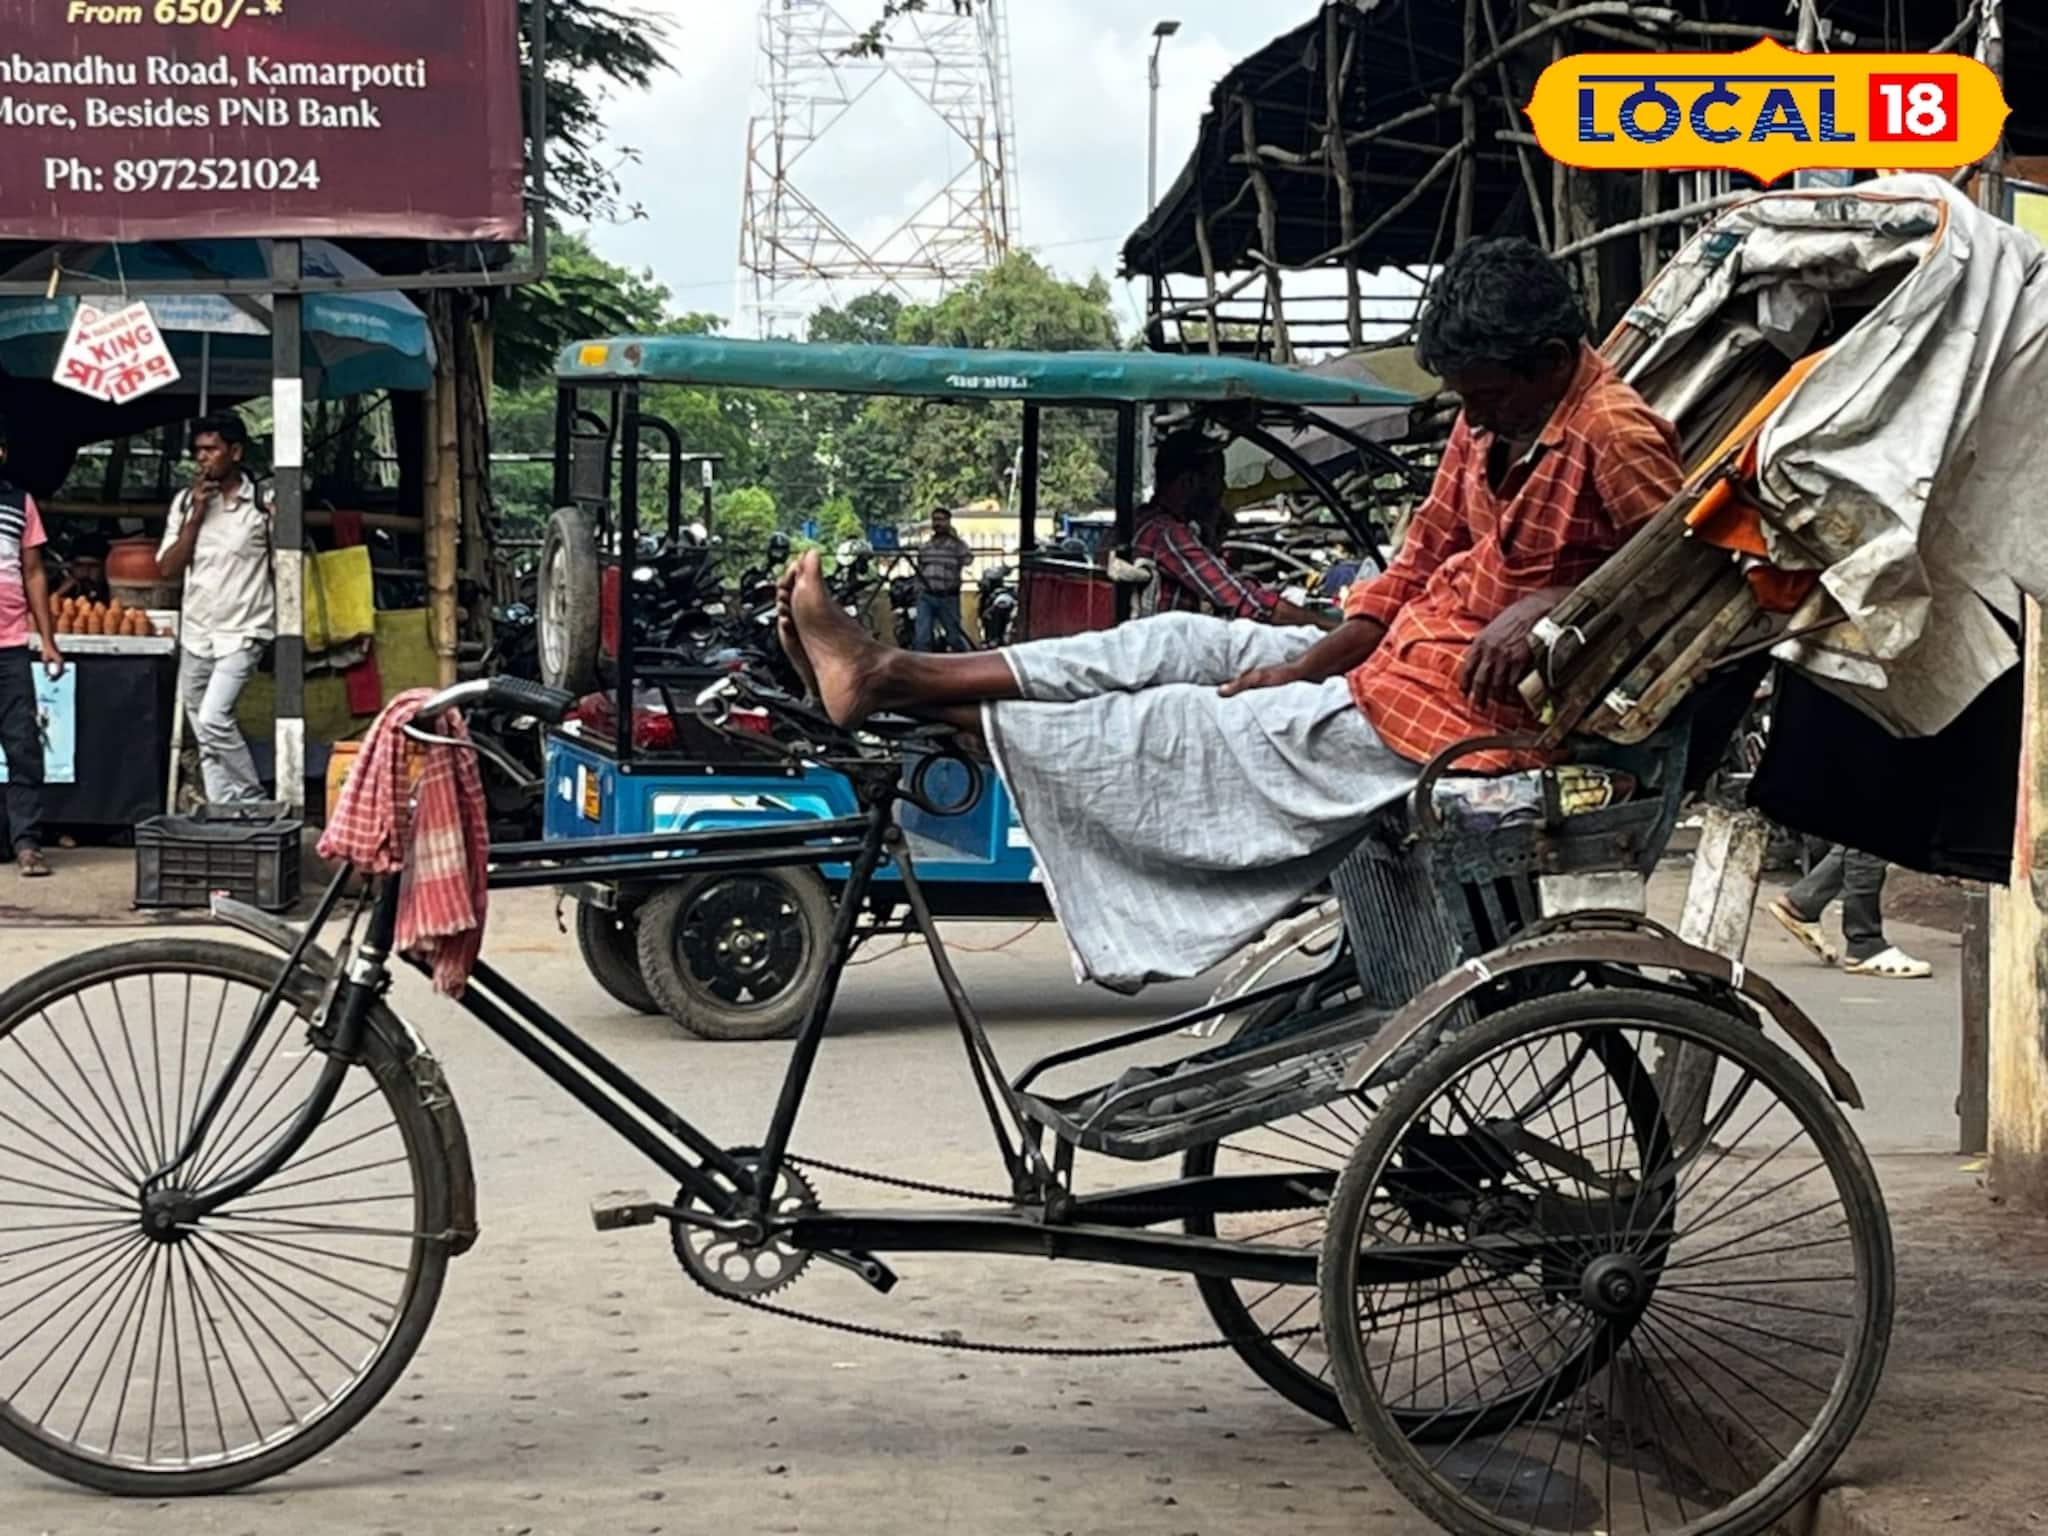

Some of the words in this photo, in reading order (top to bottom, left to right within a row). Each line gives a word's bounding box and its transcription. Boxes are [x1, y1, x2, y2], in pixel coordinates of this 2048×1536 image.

[67, 2, 142, 24] From
[147, 56, 238, 87] Road,
[247, 56, 426, 92] Kamarpotti
[86, 98, 209, 127] Besides
[219, 98, 289, 126] PNB
[299, 98, 381, 128] Bank
[45, 157, 104, 191] Ph:
[113, 157, 320, 191] 8972521024
